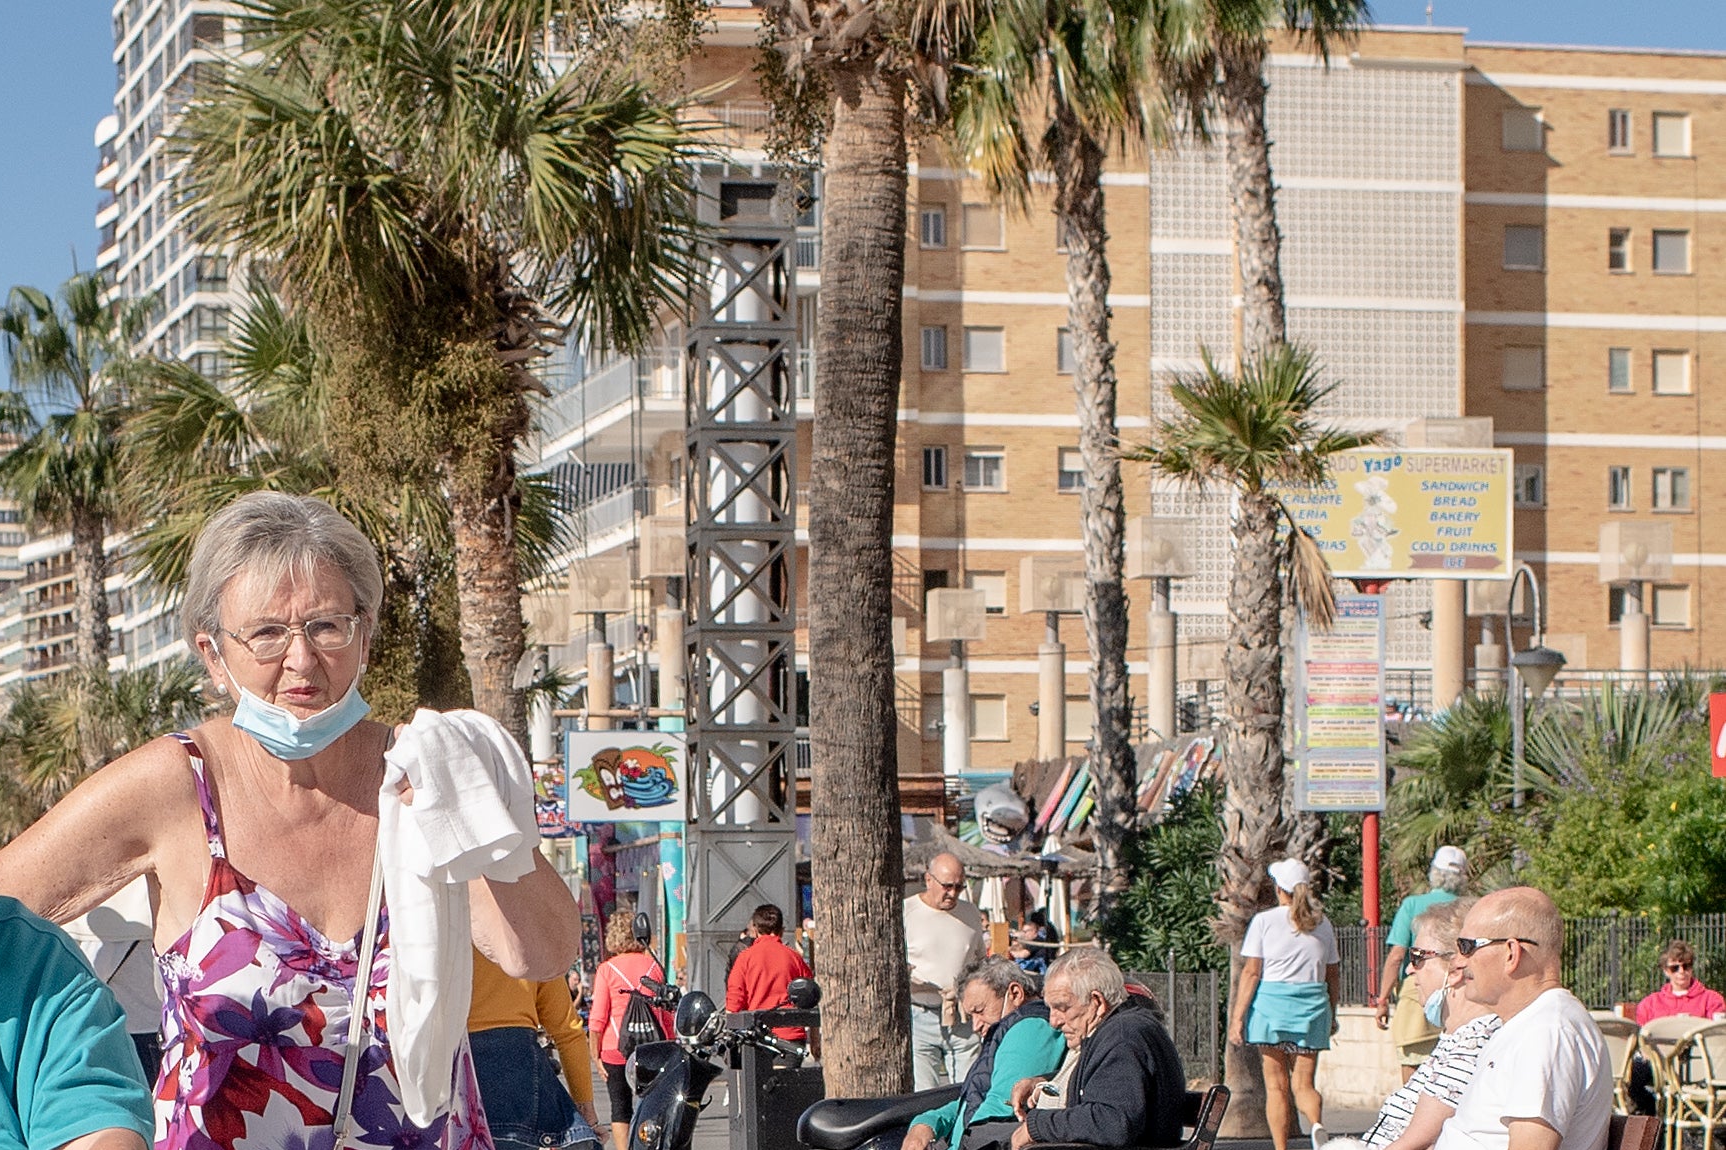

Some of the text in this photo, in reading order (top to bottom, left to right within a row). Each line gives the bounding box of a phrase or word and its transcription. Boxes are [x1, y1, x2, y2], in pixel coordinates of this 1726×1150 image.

[1363, 455, 1402, 473] Yago
[1407, 457, 1506, 474] SUPERMARKET
[1421, 480, 1489, 491] SANDWICH
[1433, 496, 1477, 506] BREAD
[1430, 511, 1480, 521] BAKERY
[1437, 526, 1473, 537] FRUIT
[1411, 541, 1497, 553] COLD DRINKS
[1443, 556, 1466, 568] ICE
